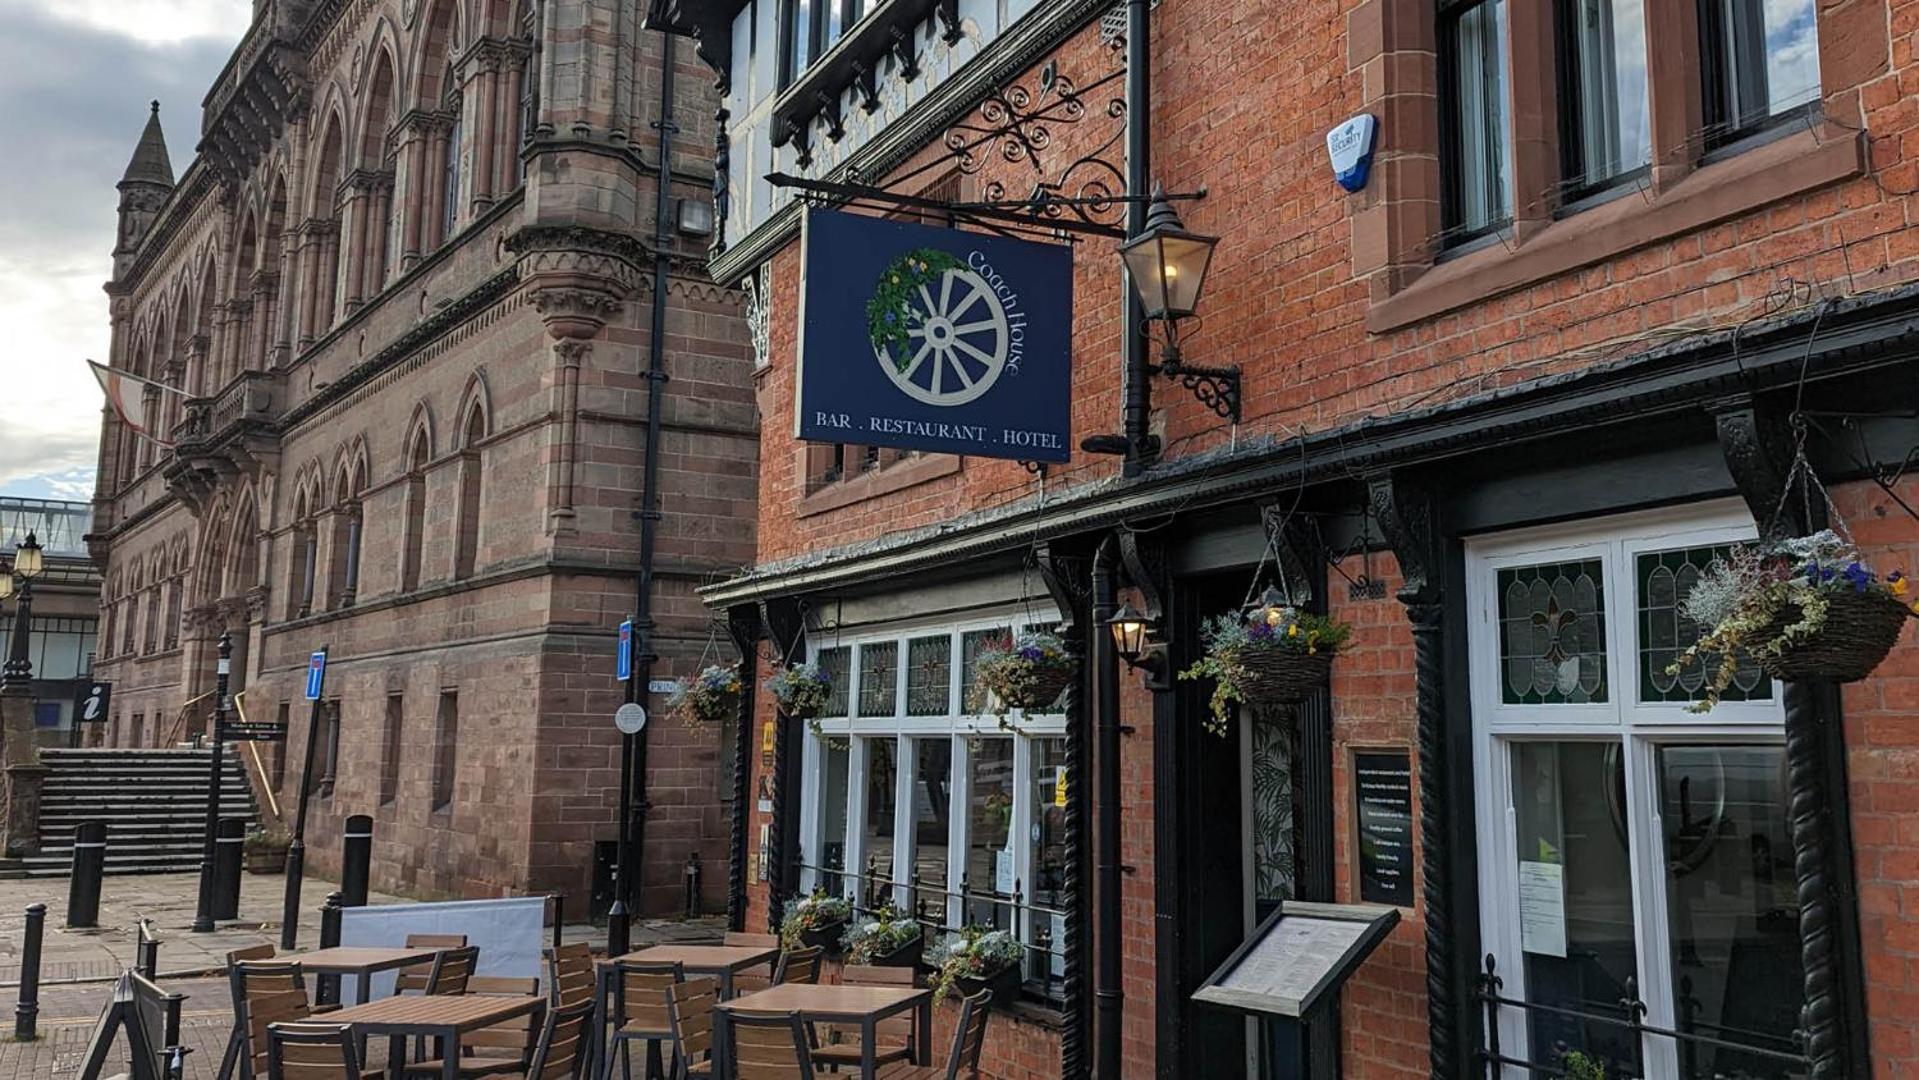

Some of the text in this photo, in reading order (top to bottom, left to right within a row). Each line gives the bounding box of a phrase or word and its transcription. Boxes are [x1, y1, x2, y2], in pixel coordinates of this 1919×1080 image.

[1331, 132, 1361, 151] SECURITY
[968, 250, 1027, 377] Coach House
[816, 411, 1062, 449] BAR RESTAURANT HOTEL
